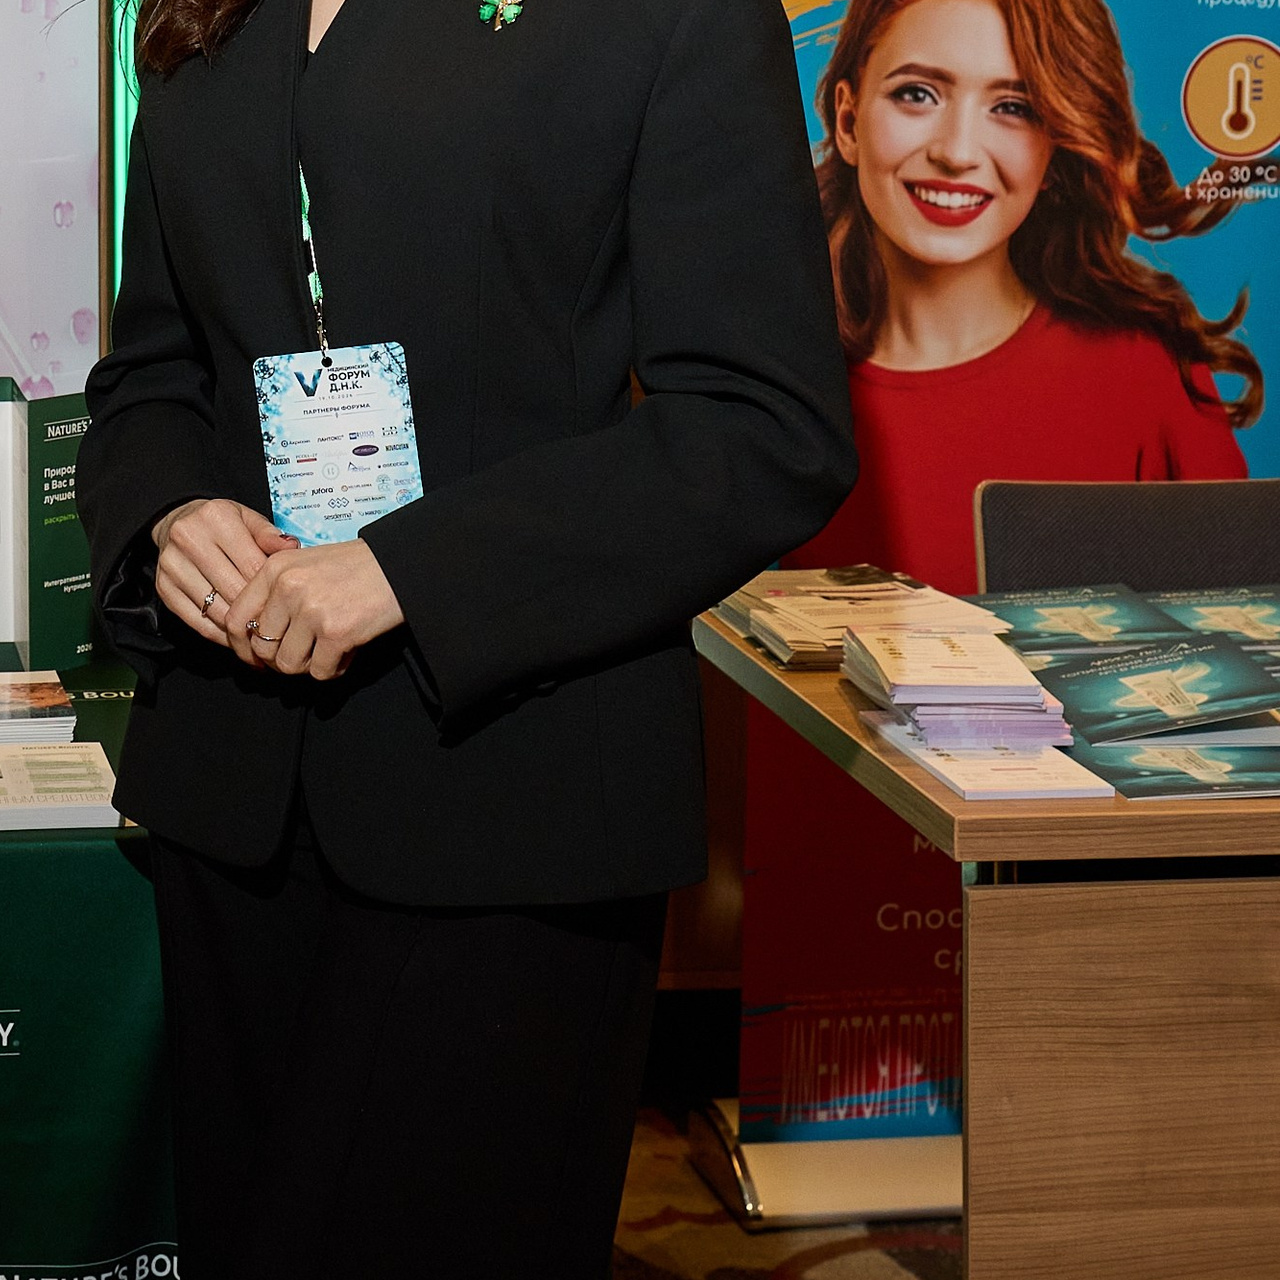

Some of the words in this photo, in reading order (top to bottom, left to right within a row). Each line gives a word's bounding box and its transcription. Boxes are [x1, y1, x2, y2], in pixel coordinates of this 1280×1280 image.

[1197, 167, 1225, 186] До
[1229, 165, 1251, 184] 30
[328, 369, 371, 382] ФОРУМ
[330, 380, 363, 394] Д.Н.К.
[47, 419, 89, 438] NATURE'S
[51, 478, 68, 491] Вас
